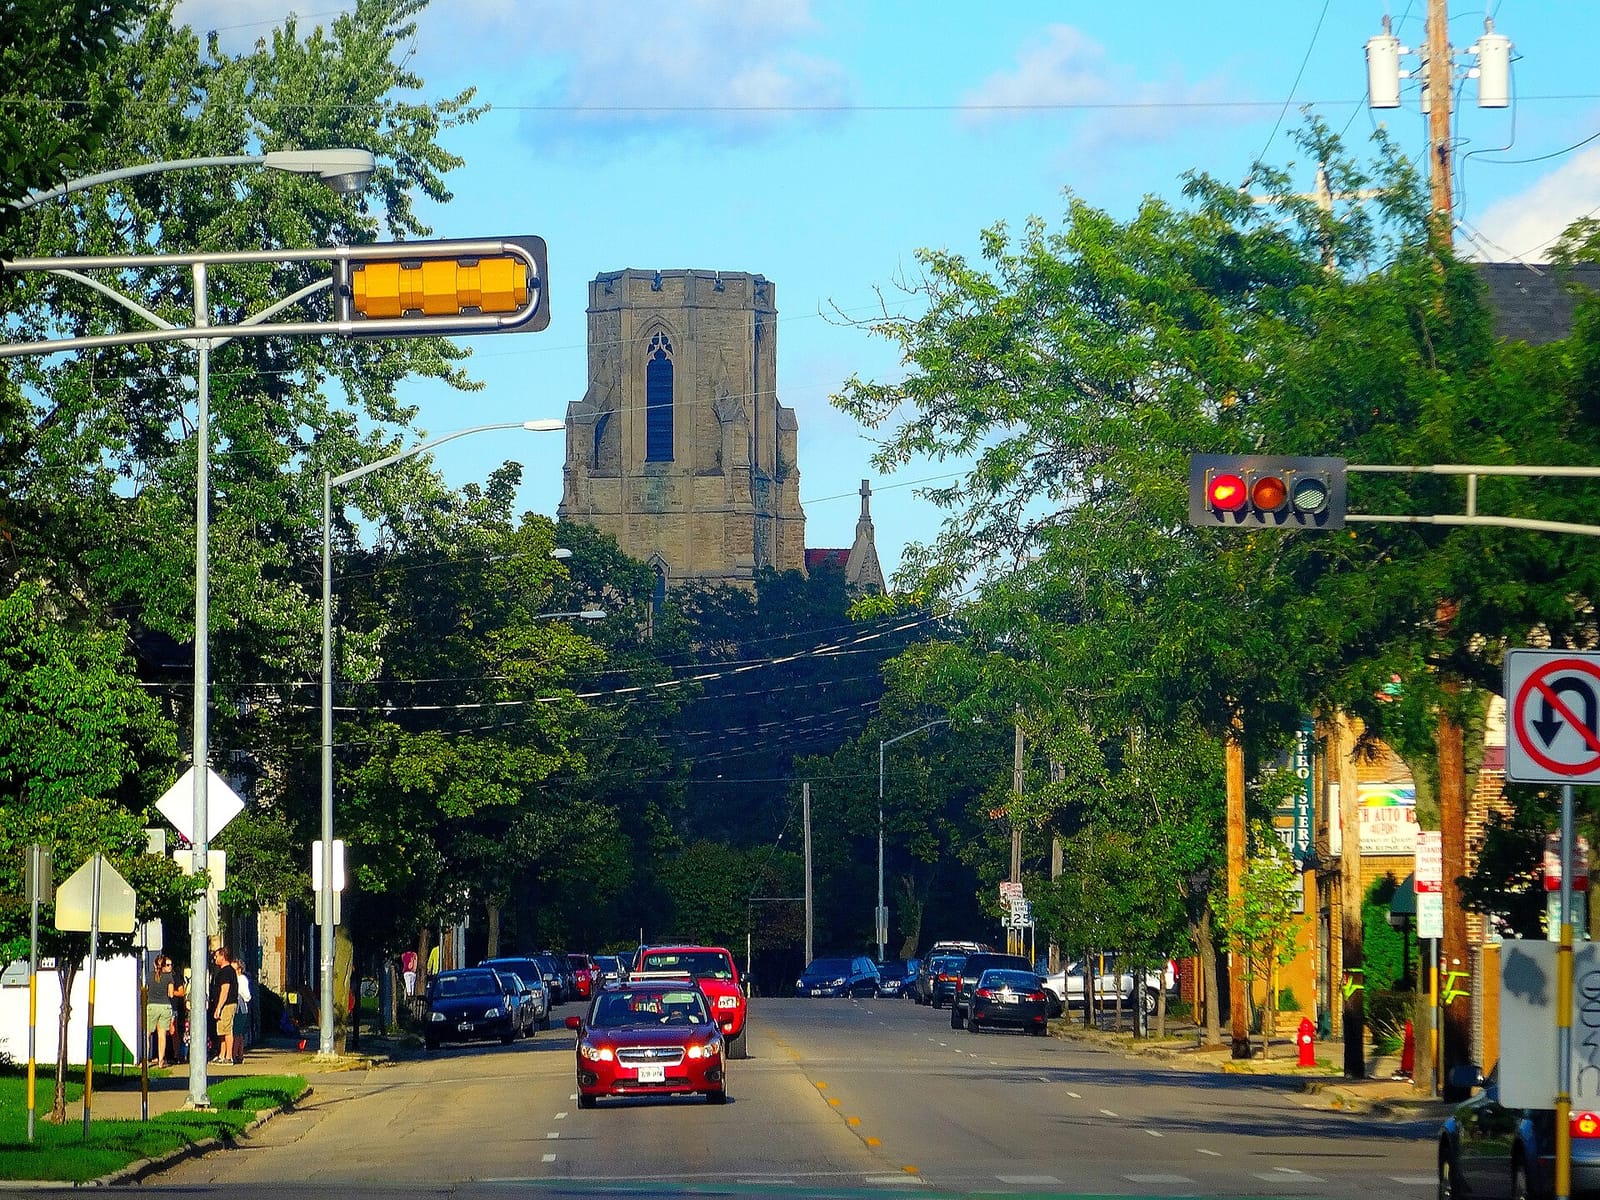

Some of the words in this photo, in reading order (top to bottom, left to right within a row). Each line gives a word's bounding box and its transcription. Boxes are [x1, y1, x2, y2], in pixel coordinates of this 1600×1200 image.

[1296, 731, 1310, 852] UPHOSTERY
[1374, 808, 1400, 822] AUTO
[1013, 913, 1030, 924] 25
